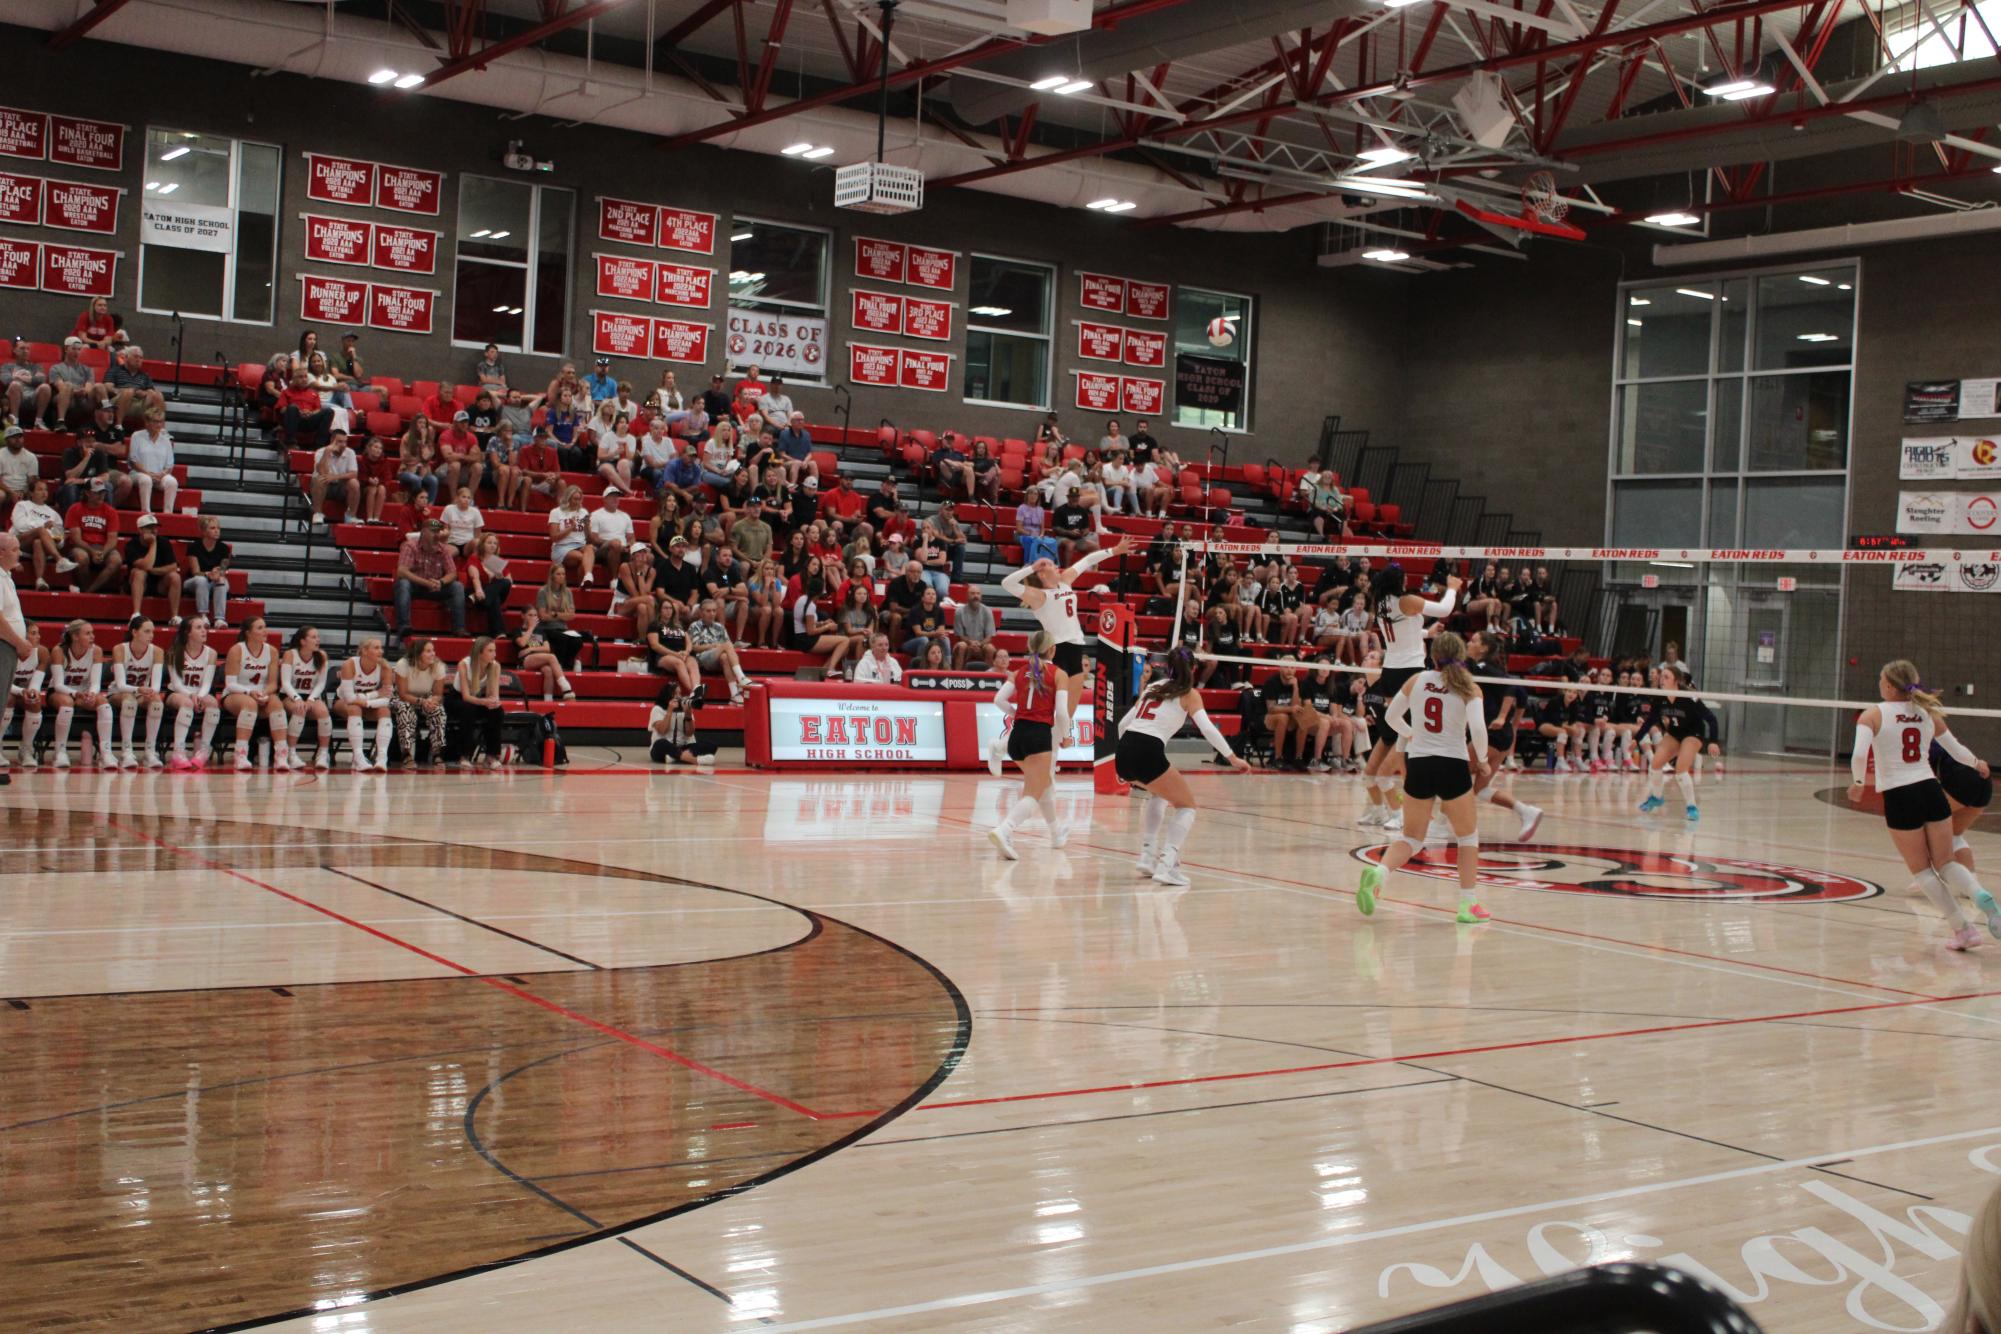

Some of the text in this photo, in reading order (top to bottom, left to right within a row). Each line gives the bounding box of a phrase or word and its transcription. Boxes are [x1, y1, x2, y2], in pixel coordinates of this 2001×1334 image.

[5, 120, 38, 136] PLACE
[76, 123, 98, 133] STATE
[10, 130, 26, 140] AAA
[60, 126, 114, 147] FINAL FOUR
[70, 140, 103, 150] 2020 AAA
[76, 148, 113, 159] BASKETBALL
[76, 154, 94, 162] EATON
[332, 162, 352, 171] STATE
[316, 163, 366, 184] CHAMPIONS
[399, 171, 418, 180] STATE
[343, 179, 356, 188] AAA
[384, 173, 432, 193] CHAMPIONS
[0, 185, 33, 201] PLACE
[70, 187, 92, 196] STATE
[327, 184, 353, 194] SOFTBALL
[409, 189, 421, 198] AAA
[5, 195, 20, 205] AAA
[53, 190, 109, 210] CHAMPIONS
[332, 191, 347, 199] EATON
[63, 203, 97, 215] 2020 AAA
[63, 212, 97, 222] WRESTLING
[144, 212, 230, 229] EATON HIGH SCHOOL
[607, 206, 650, 226] 2ND PLACE
[154, 223, 182, 233] CLASS
[197, 228, 218, 237] 2027
[329, 222, 349, 231] STATE
[666, 216, 708, 234] 4TH PLACE
[314, 224, 363, 244] CHAMPIONS
[394, 231, 413, 239] STATE
[340, 239, 353, 248] AAA
[380, 233, 428, 252] CHAMPIONS
[321, 244, 354, 254] VOLLEYBALL
[863, 245, 900, 263] CHAMPIONS
[4, 251, 31, 266] FOUR
[68, 251, 90, 260] STATE
[329, 251, 345, 259] EATON
[390, 253, 415, 262] FOOTBALL
[3, 261, 17, 270] AAA
[51, 254, 107, 274] CHAMPIONS
[912, 254, 949, 270] CHAMPIONS
[63, 268, 93, 279] 2020 AA
[605, 262, 648, 281] CHAMPIONS
[63, 276, 92, 286] FOOTBALL
[662, 270, 707, 288] THIRD PLACE
[68, 283, 86, 291] EATON
[325, 282, 345, 291] STATE
[1085, 279, 1121, 295] FINAL FOUR
[310, 285, 360, 304] RUNNER UP
[392, 290, 411, 299] STATE
[1131, 288, 1164, 302] CHAMPIONS
[320, 298, 349, 308] 2021 AAA
[378, 293, 425, 312] FINAL FOUR
[859, 297, 878, 311] FINAL
[879, 303, 897, 315] FOUR
[319, 305, 349, 315] WRESTLING
[402, 307, 415, 315] AAA
[909, 306, 945, 321] 3RD PLACE
[392, 319, 408, 327] EATON
[672, 324, 689, 332] STATE
[602, 320, 645, 338] CHAMPIONS
[729, 317, 822, 342] CLASS OF
[1083, 328, 1102, 340] FINAL
[658, 326, 702, 344] CHAMPIONS
[1127, 336, 1145, 347] FINAL
[753, 339, 797, 358] 2026
[856, 351, 894, 367] CHAMPIONS
[905, 357, 925, 369] FINAL
[927, 362, 945, 373] FOUR
[1081, 378, 1116, 394] CHAMPIONS
[1205, 376, 1243, 388] SCHOOL
[1125, 383, 1143, 395] FINAL
[1906, 507, 1946, 515] Slaughter
[1910, 515, 1942, 523] Roofing
[1214, 543, 1239, 551] EATON
[1296, 545, 1323, 553] EATON
[1386, 546, 1441, 555] EATON REDS
[1484, 547, 1545, 557] EATON REDS
[1592, 550, 1660, 558] EATON REDS
[1711, 551, 1785, 560] EATON REDS
[1842, 551, 1926, 561] EATON REDS
[1065, 598, 1074, 618] 6
[250, 672, 261, 685] 4
[294, 678, 311, 690] 18
[949, 679, 966, 689] POSS
[1424, 682, 1449, 695] Reds
[1026, 680, 1035, 710] 1
[1095, 661, 1107, 740] EATON
[838, 702, 871, 711] Welcome
[1106, 680, 1114, 723] REDS
[1136, 696, 1162, 721] 12
[1424, 697, 1443, 733] 9
[1895, 714, 1923, 723] Reds
[799, 715, 917, 745] EATON
[1902, 727, 1921, 763] 8
[807, 749, 913, 759] HIGH SCHOOL
